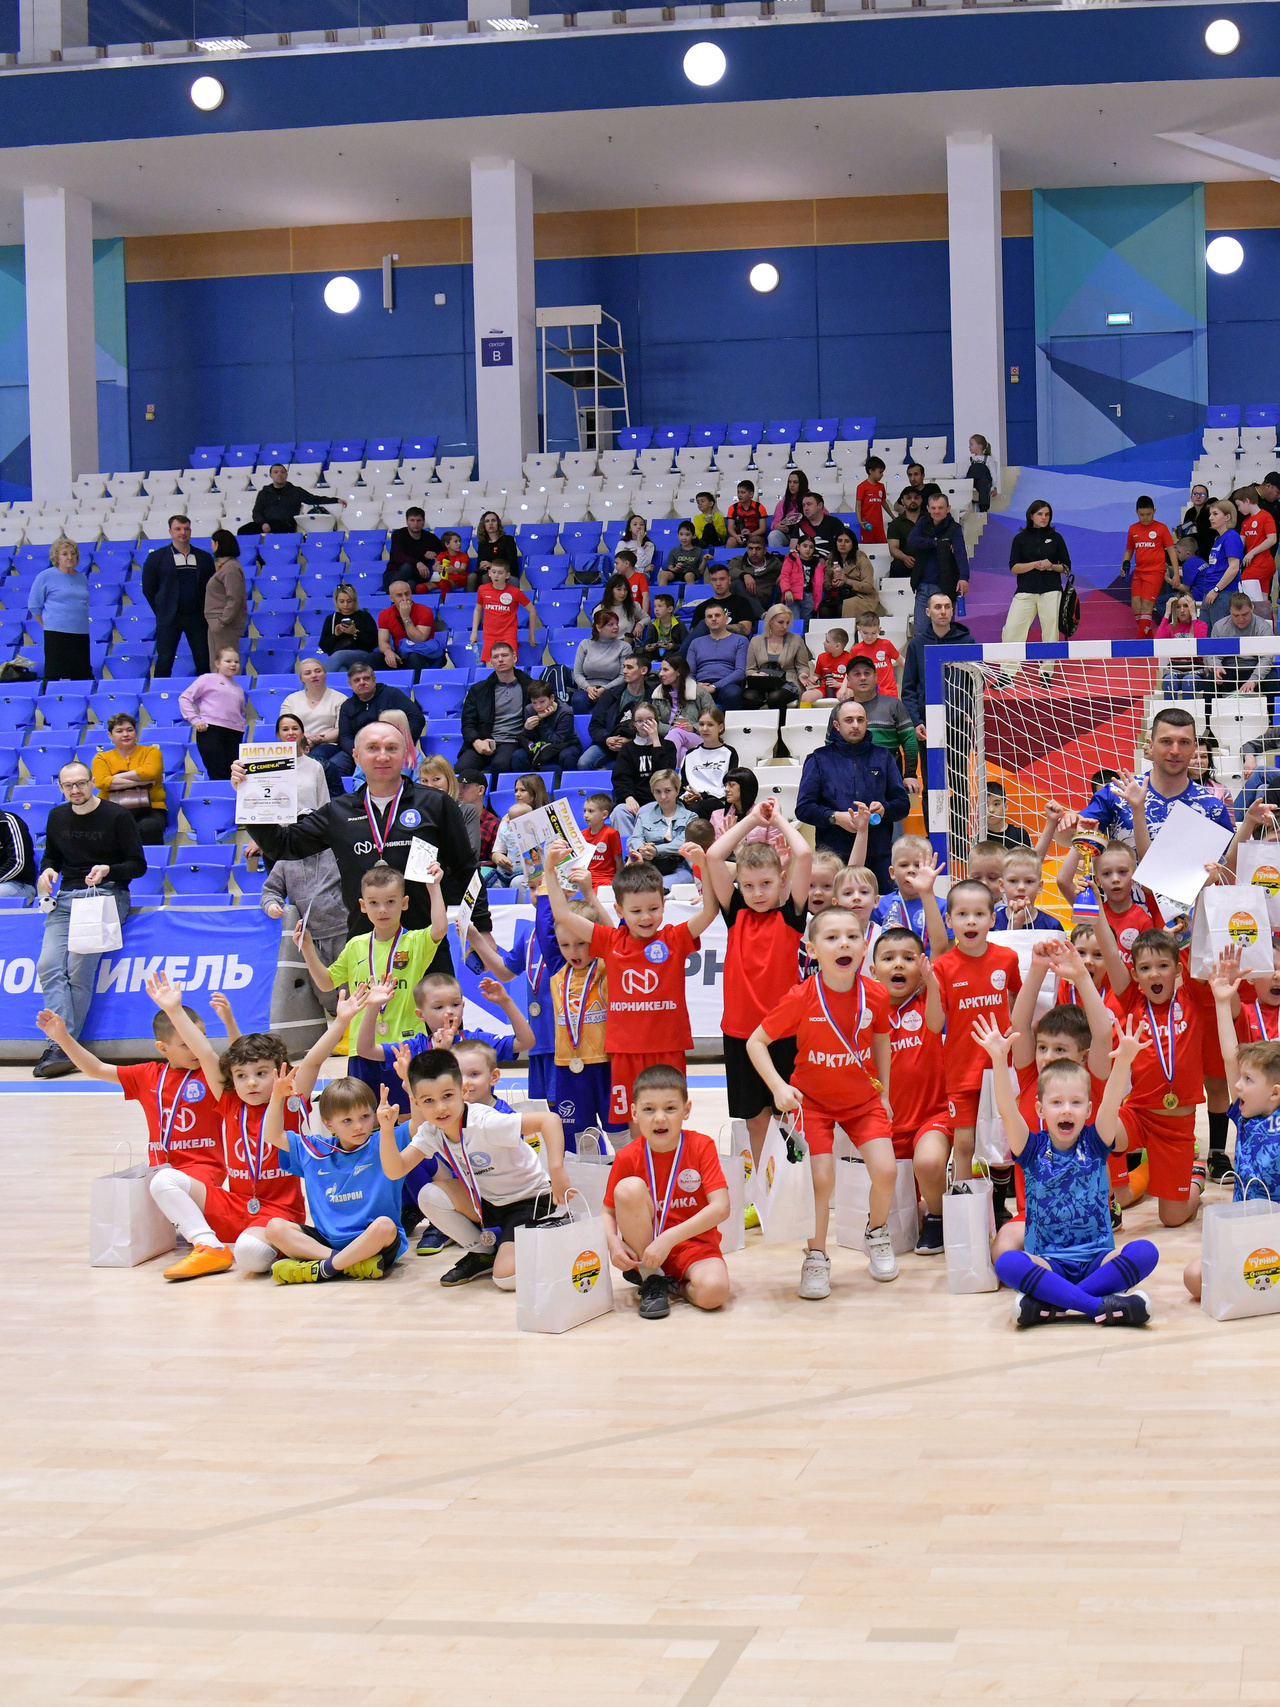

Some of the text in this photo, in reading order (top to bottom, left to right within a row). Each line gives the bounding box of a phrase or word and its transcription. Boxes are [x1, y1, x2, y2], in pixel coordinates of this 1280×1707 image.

[242, 746, 294, 757] ДИПЛОМ
[264, 788, 271, 798] 2
[609, 1001, 677, 1012] НОРНИКЕЛЬ
[958, 993, 1003, 1010] АРКТИКА
[612, 1085, 629, 1115] 3
